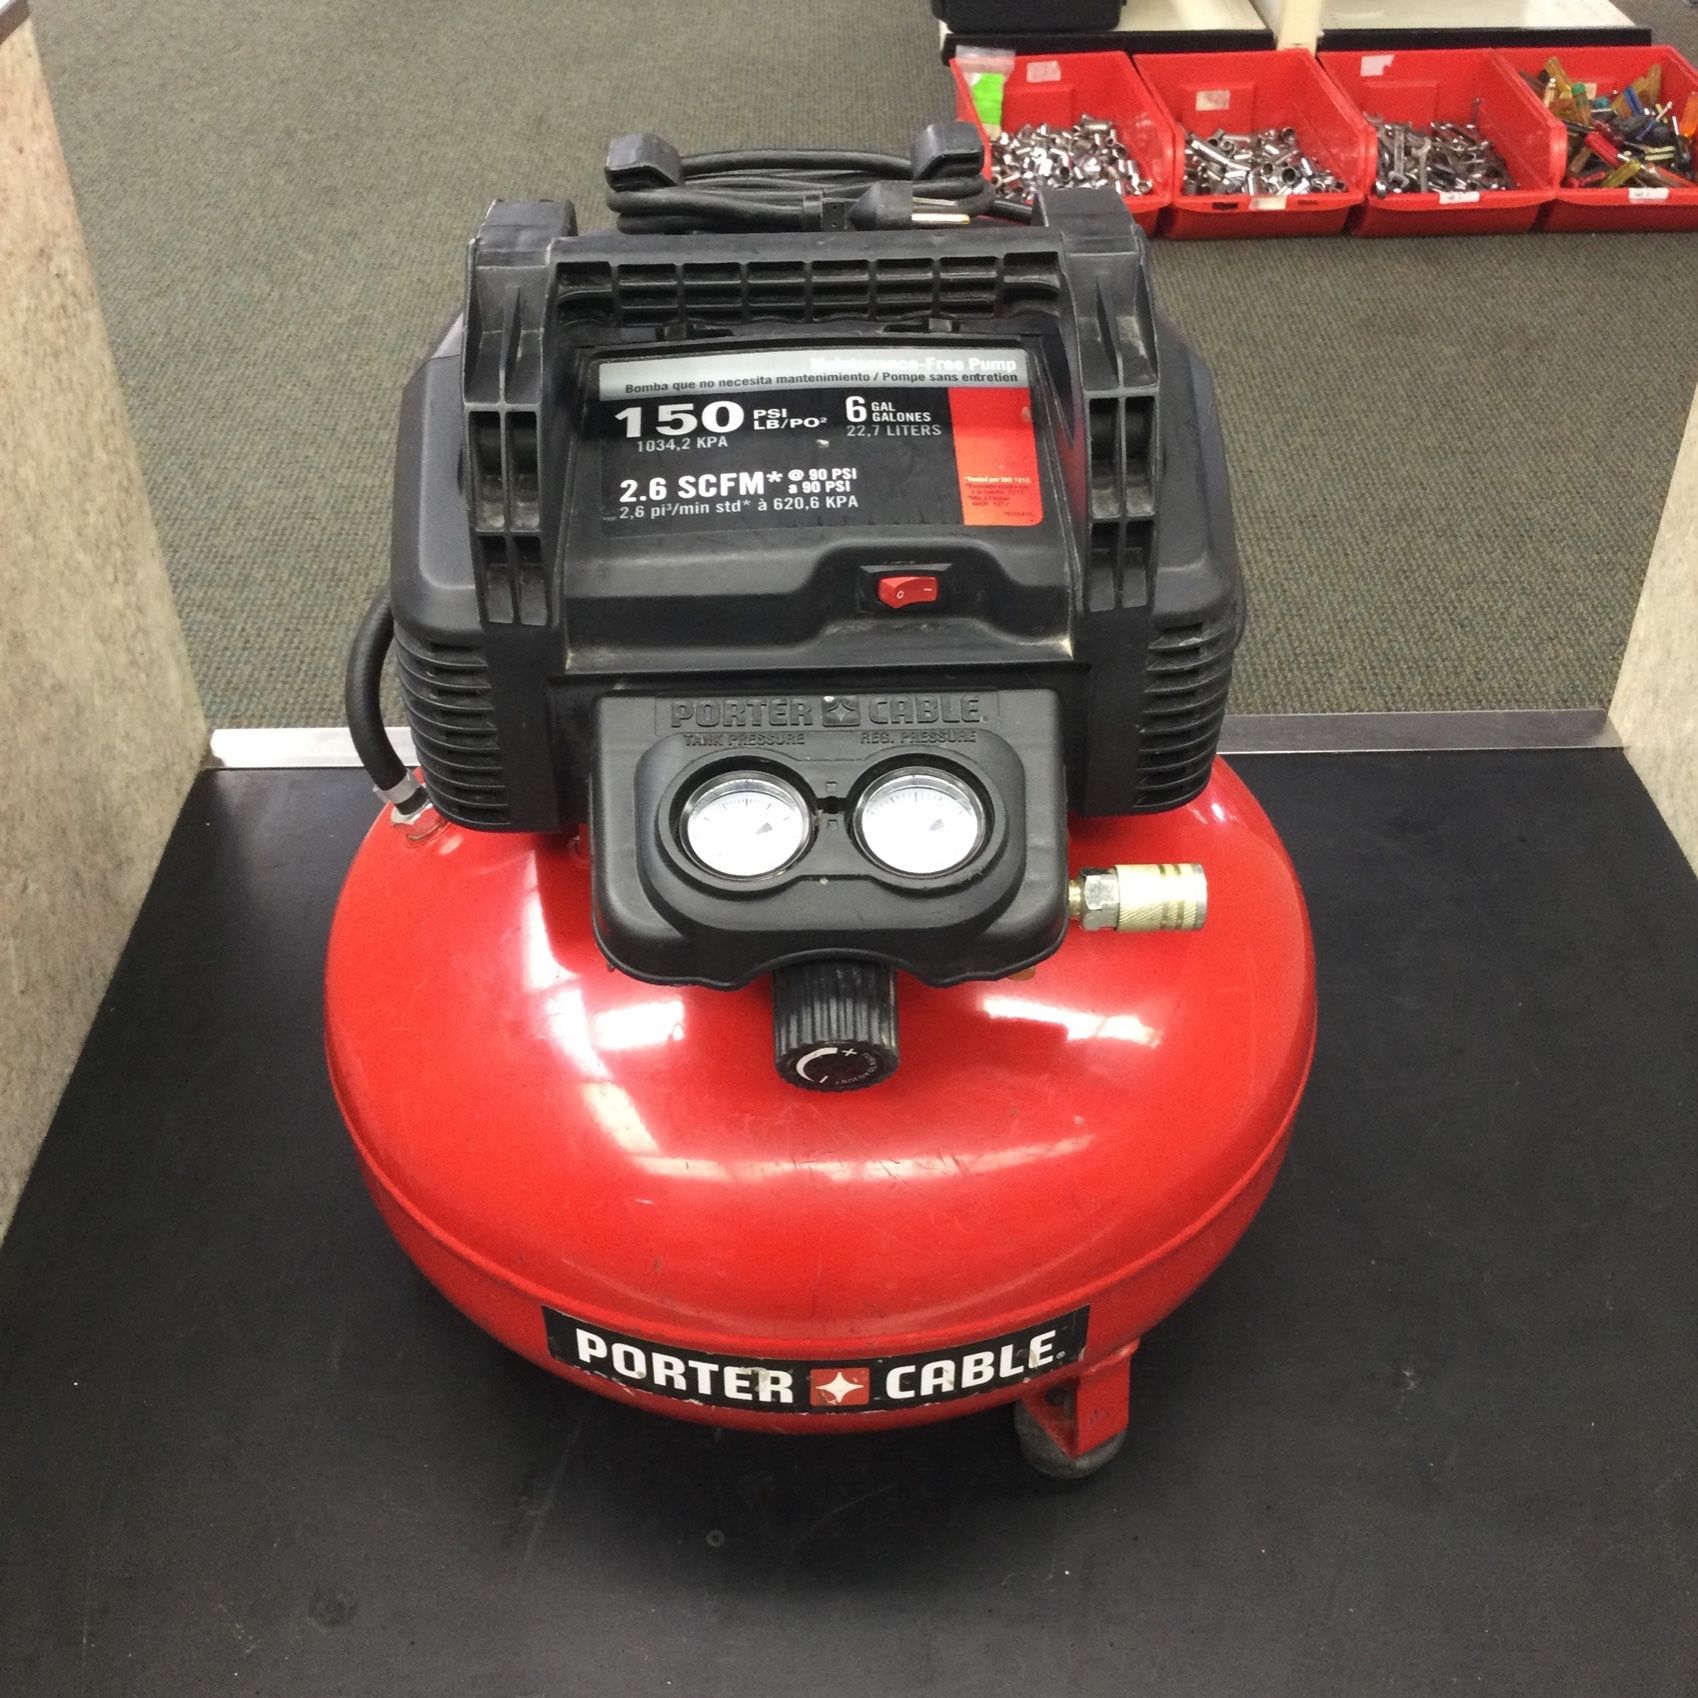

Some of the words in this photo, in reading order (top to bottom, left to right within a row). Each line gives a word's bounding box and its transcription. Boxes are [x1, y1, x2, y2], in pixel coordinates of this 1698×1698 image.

[968, 357, 1017, 373] Pump
[625, 383, 668, 394] Bomba
[672, 382, 696, 392] que
[699, 380, 715, 389] no
[719, 377, 772, 388] necesita
[776, 373, 870, 384] mantenimiento
[883, 373, 925, 384] Pompe
[929, 373, 958, 382] sans
[962, 373, 1018, 382] entretien
[753, 408, 787, 419] PSI
[845, 396, 867, 422] 6
[871, 402, 896, 412] GAL
[614, 400, 745, 438] 150
[872, 412, 931, 422] GALONES
[846, 425, 879, 437] 22,7
[886, 424, 942, 436] LITERS
[637, 438, 690, 452] 1034,2
[697, 436, 728, 449] KPA
[788, 469, 804, 481] @
[809, 469, 827, 480] 90
[832, 468, 857, 480] PSI
[619, 478, 667, 503] 2.6
[788, 484, 798, 494] a
[803, 482, 820, 493] 90
[825, 481, 850, 492] PSI
[619, 505, 645, 519] 2,6
[758, 499, 768, 511] à
[773, 497, 820, 511] 620,6
[826, 496, 859, 509] KPA
[671, 699, 814, 728] PORTER
[684, 733, 724, 746] TANK
[728, 733, 805, 746] PRESSURE
[860, 731, 895, 744] REG.
[900, 731, 977, 743] PRESSURE
[576, 1328, 793, 1403] PORTER
